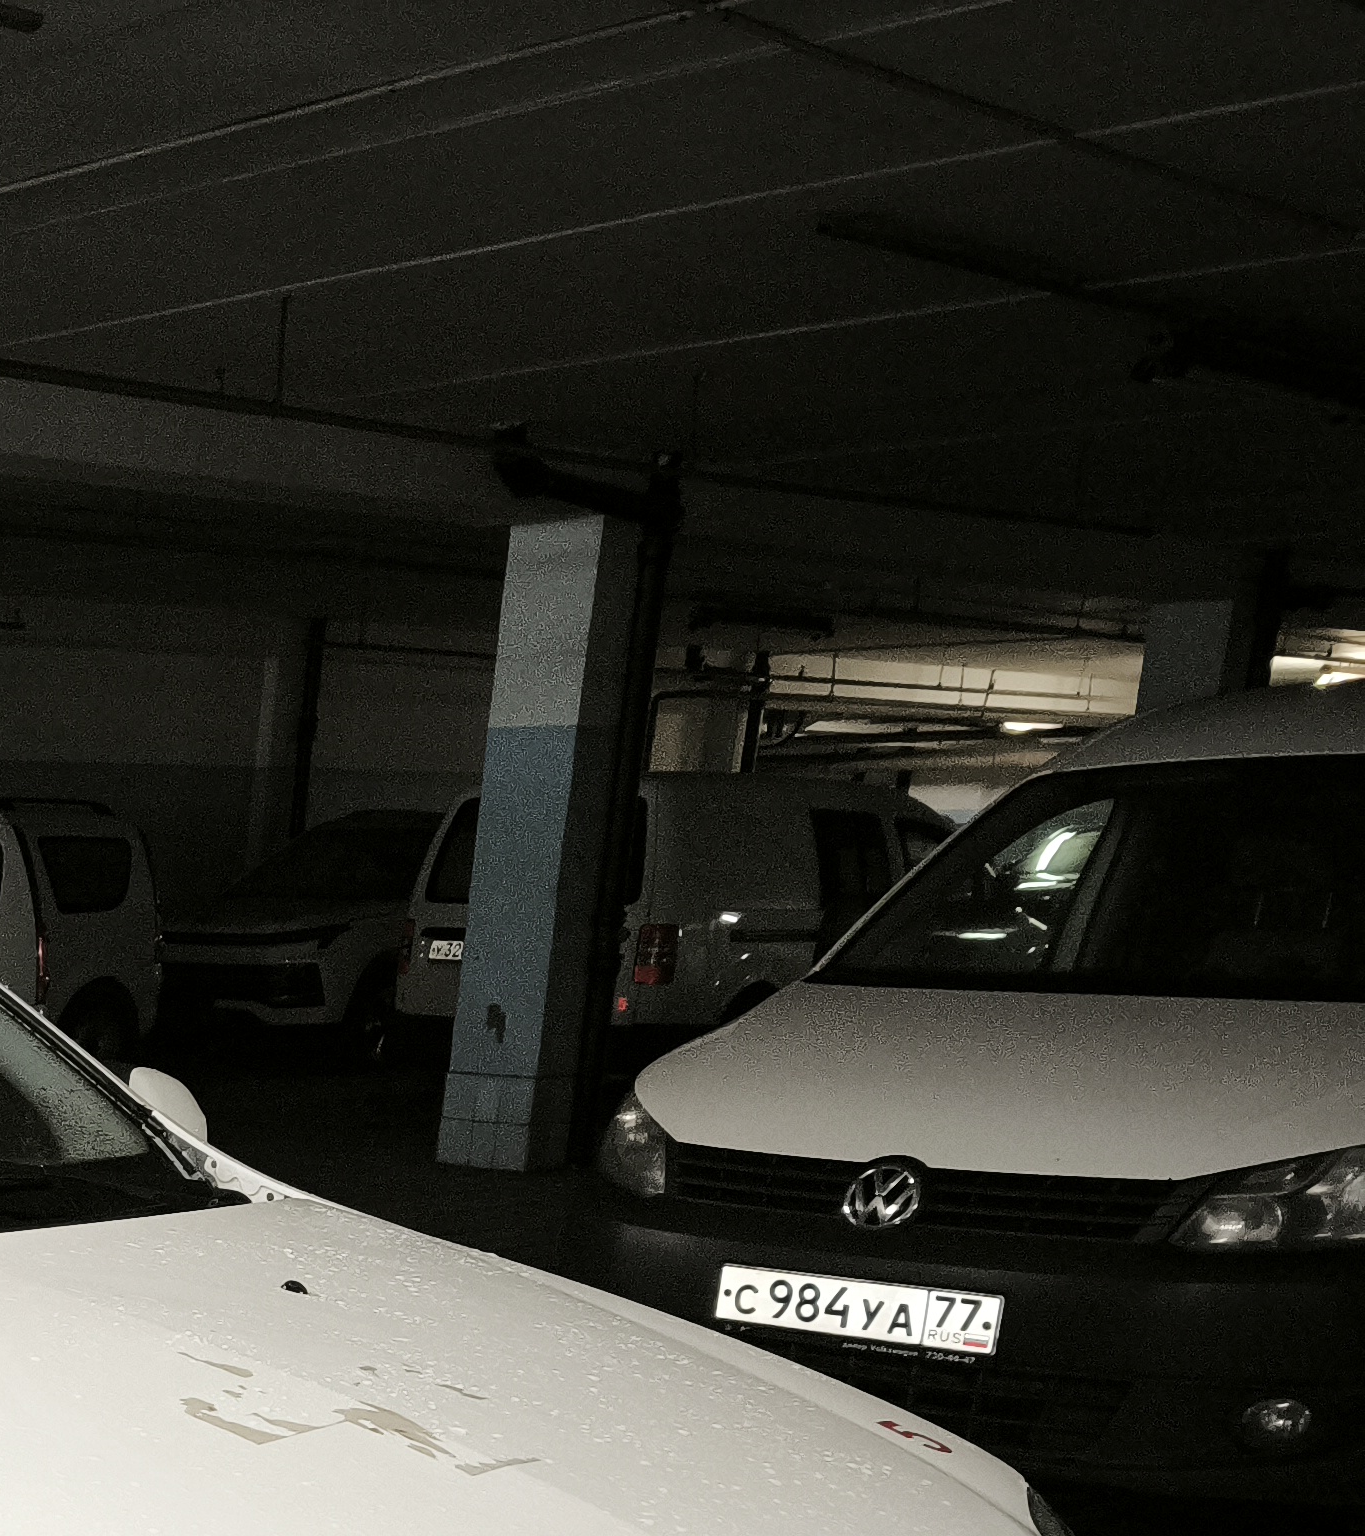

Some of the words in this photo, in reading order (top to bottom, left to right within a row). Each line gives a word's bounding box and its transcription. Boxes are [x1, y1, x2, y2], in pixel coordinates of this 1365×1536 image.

[733, 1279, 913, 1338] С984УА
[934, 1295, 983, 1333] 77
[927, 1330, 962, 1345] RUS
